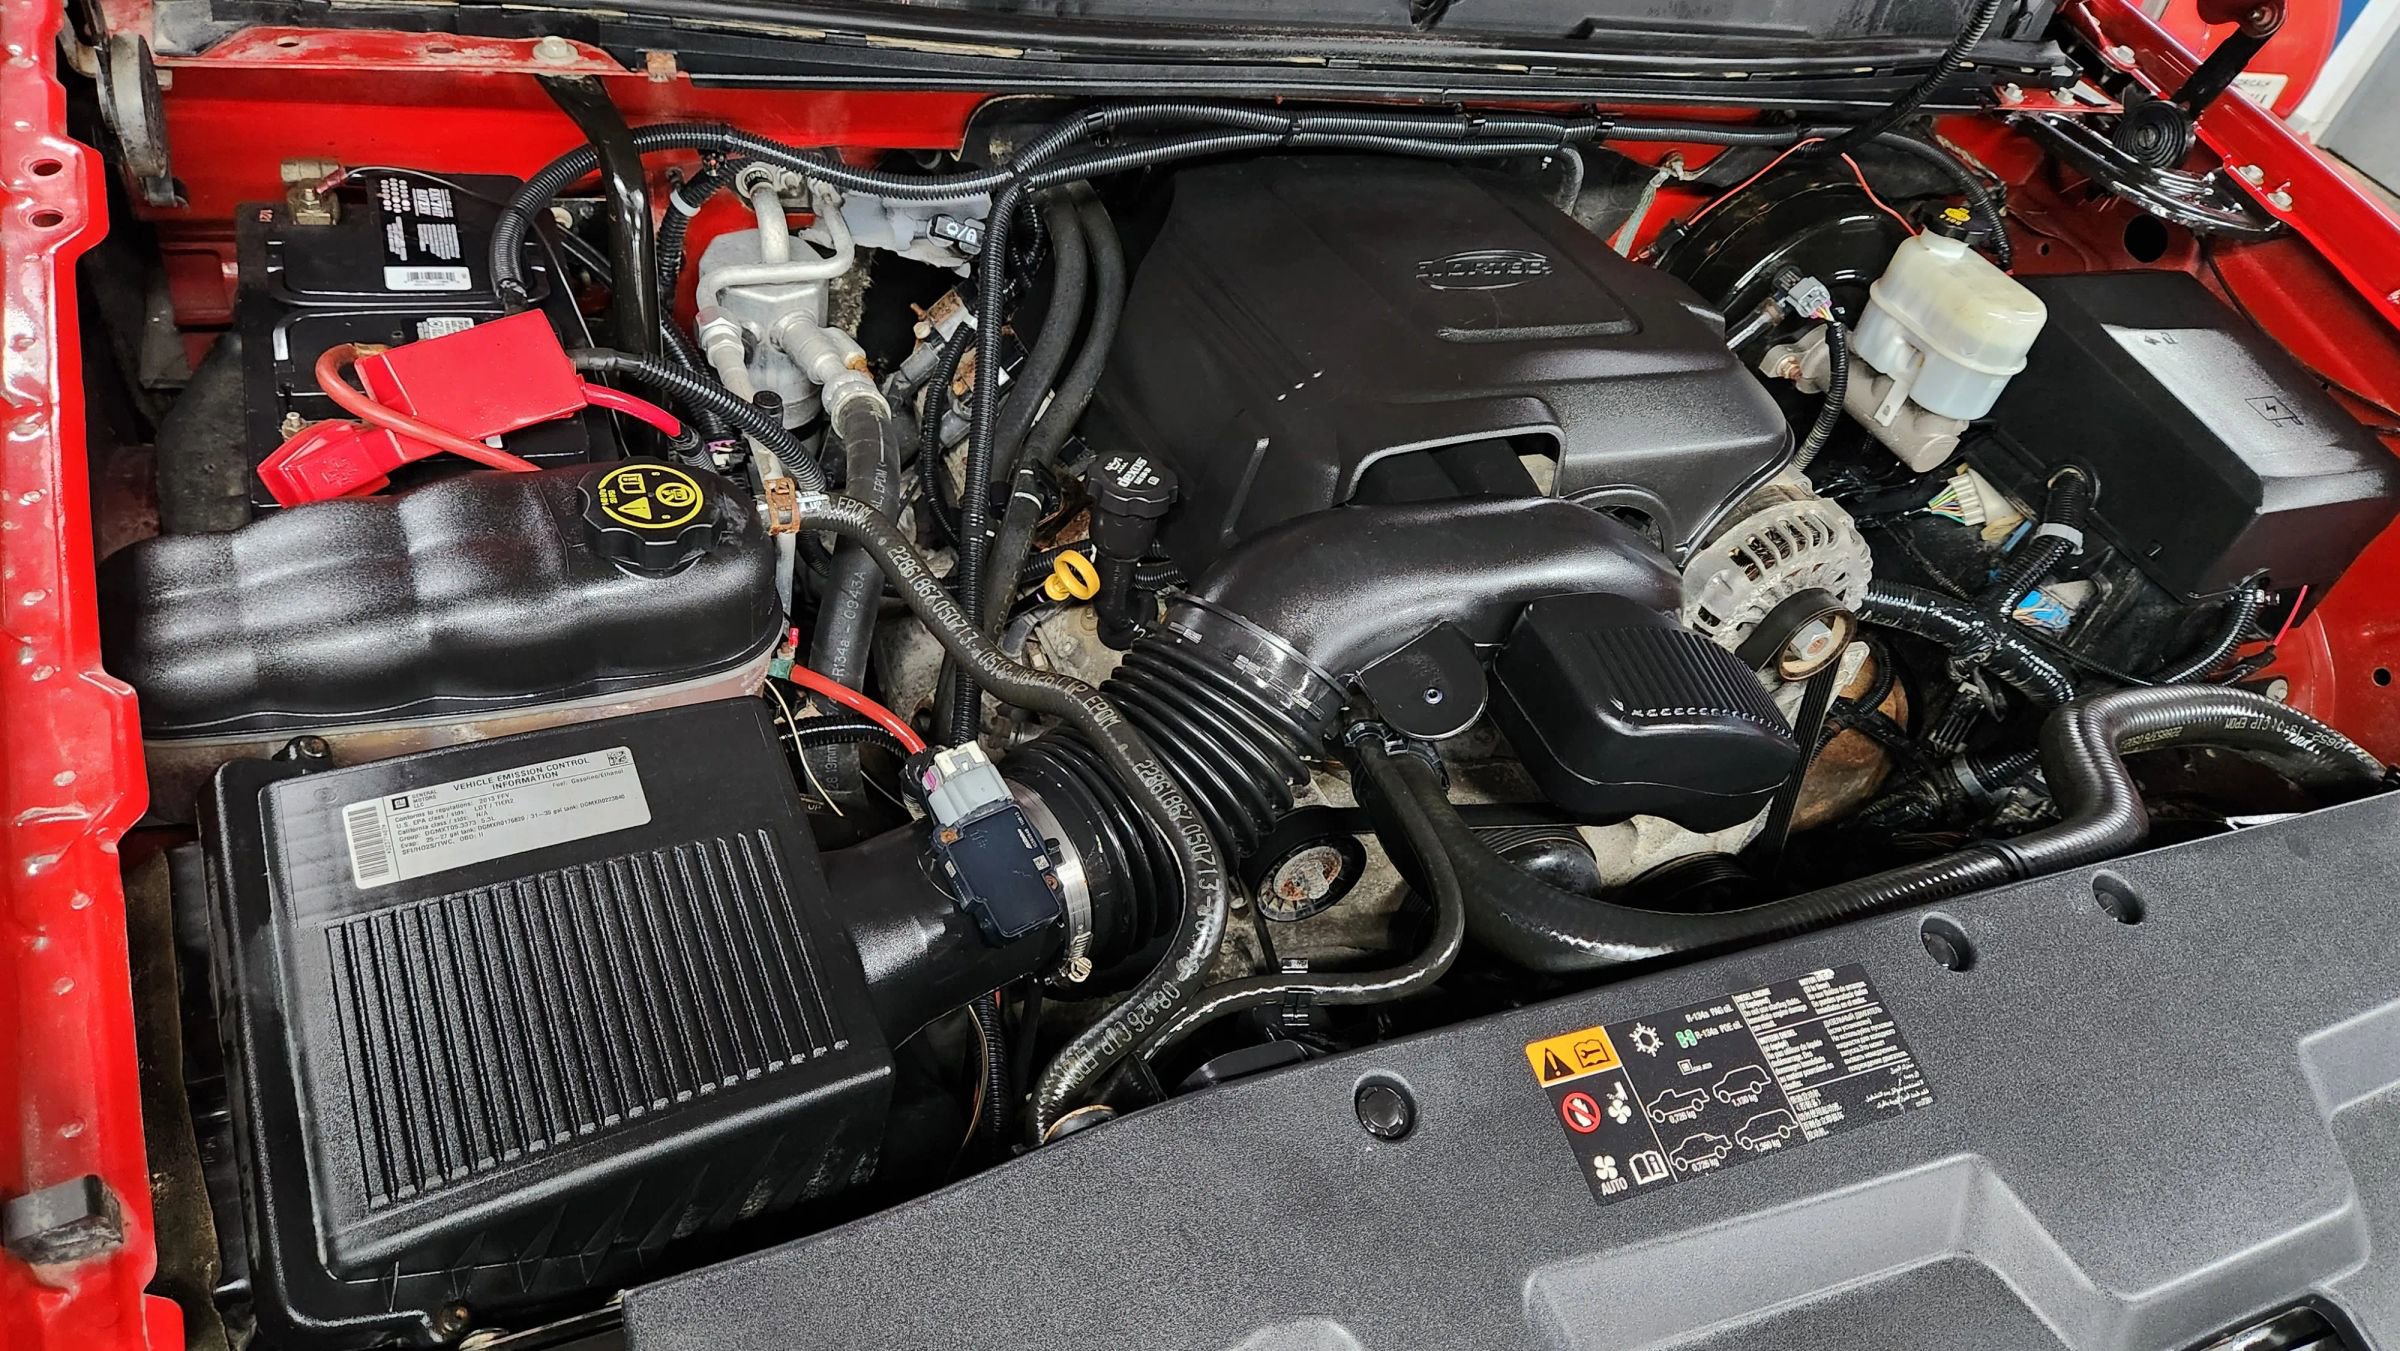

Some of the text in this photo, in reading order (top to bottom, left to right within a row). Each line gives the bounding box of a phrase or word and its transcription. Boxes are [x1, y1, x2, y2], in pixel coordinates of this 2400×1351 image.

[1117, 456, 1147, 488] dexos
[453, 758, 588, 790] VEHICLE EMISSION CONTROL
[493, 769, 557, 789] INFORMATION
[412, 790, 436, 798] GENERAL
[1133, 756, 1192, 821] 22861867
[395, 812, 424, 822] Conforms
[479, 796, 495, 804] 2013
[413, 795, 436, 803] MOTORS
[398, 825, 428, 835] California
[1601, 1177, 1628, 1196] AUTO
